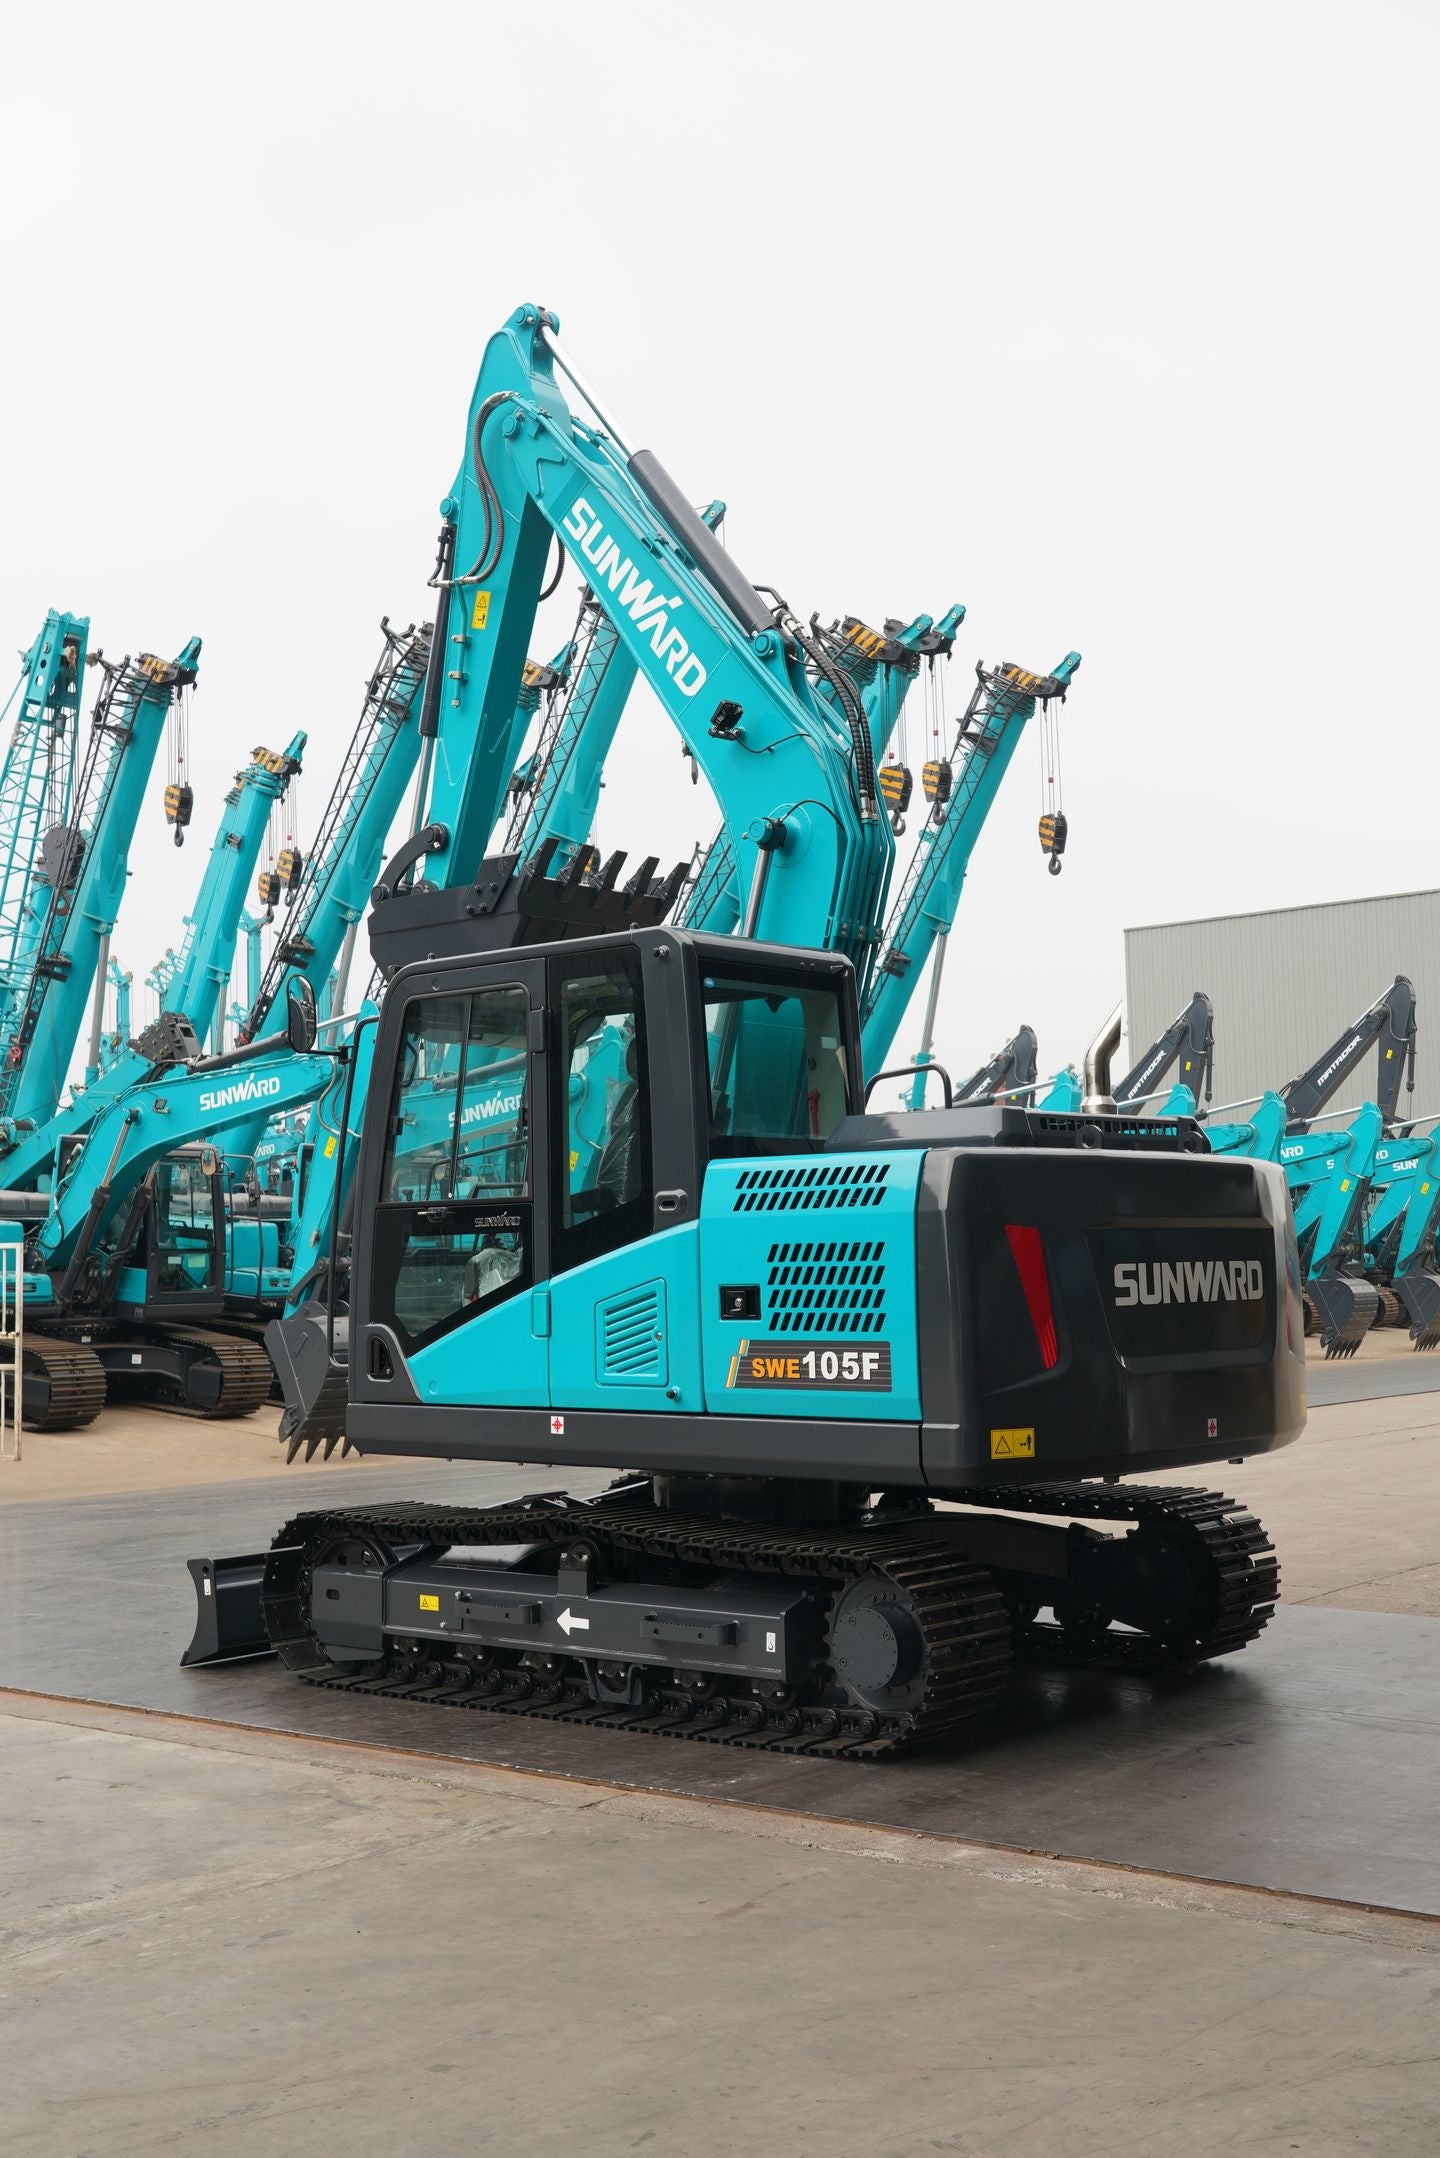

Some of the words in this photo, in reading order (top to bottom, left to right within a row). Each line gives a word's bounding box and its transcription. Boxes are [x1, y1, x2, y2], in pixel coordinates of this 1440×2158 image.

[563, 498, 706, 696] SUNWARD
[1127, 1050, 1167, 1100] MATADOR
[1317, 1035, 1363, 1086] MATADOR
[199, 1072, 280, 1111] SUNWARD
[1114, 1260, 1264, 1306] SUNWARD
[752, 1351, 880, 1380] SWE105F
